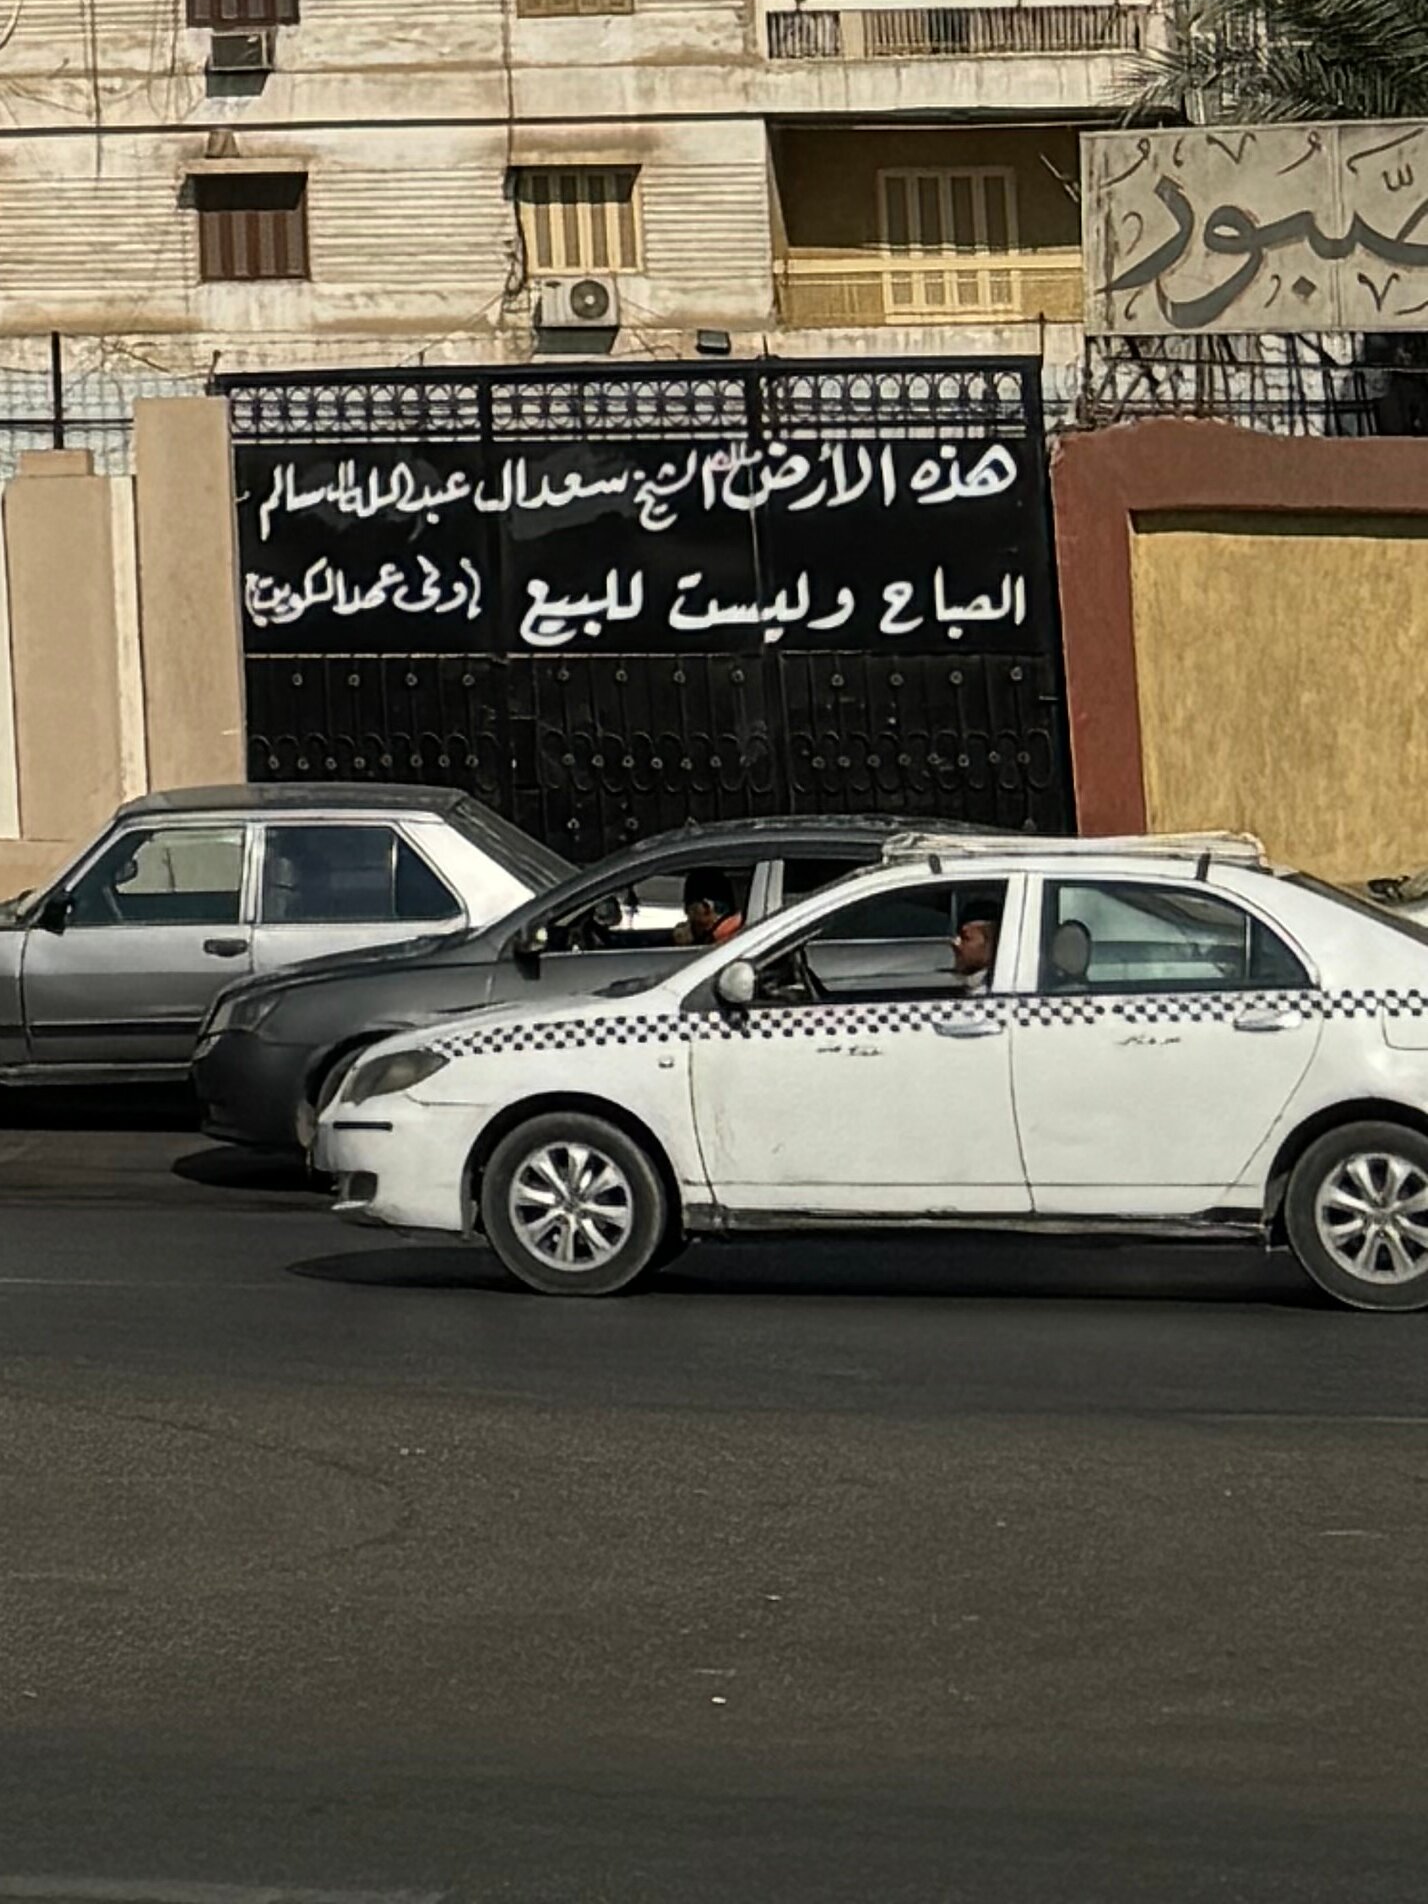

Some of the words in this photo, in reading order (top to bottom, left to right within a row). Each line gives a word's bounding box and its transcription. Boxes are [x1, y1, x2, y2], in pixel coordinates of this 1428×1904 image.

[632, 448, 714, 532] الشيخ
[909, 443, 1018, 506] هذه
[520, 569, 645, 647] للبيع
[668, 569, 857, 644] وليست
[878, 565, 1027, 641] الصباح
